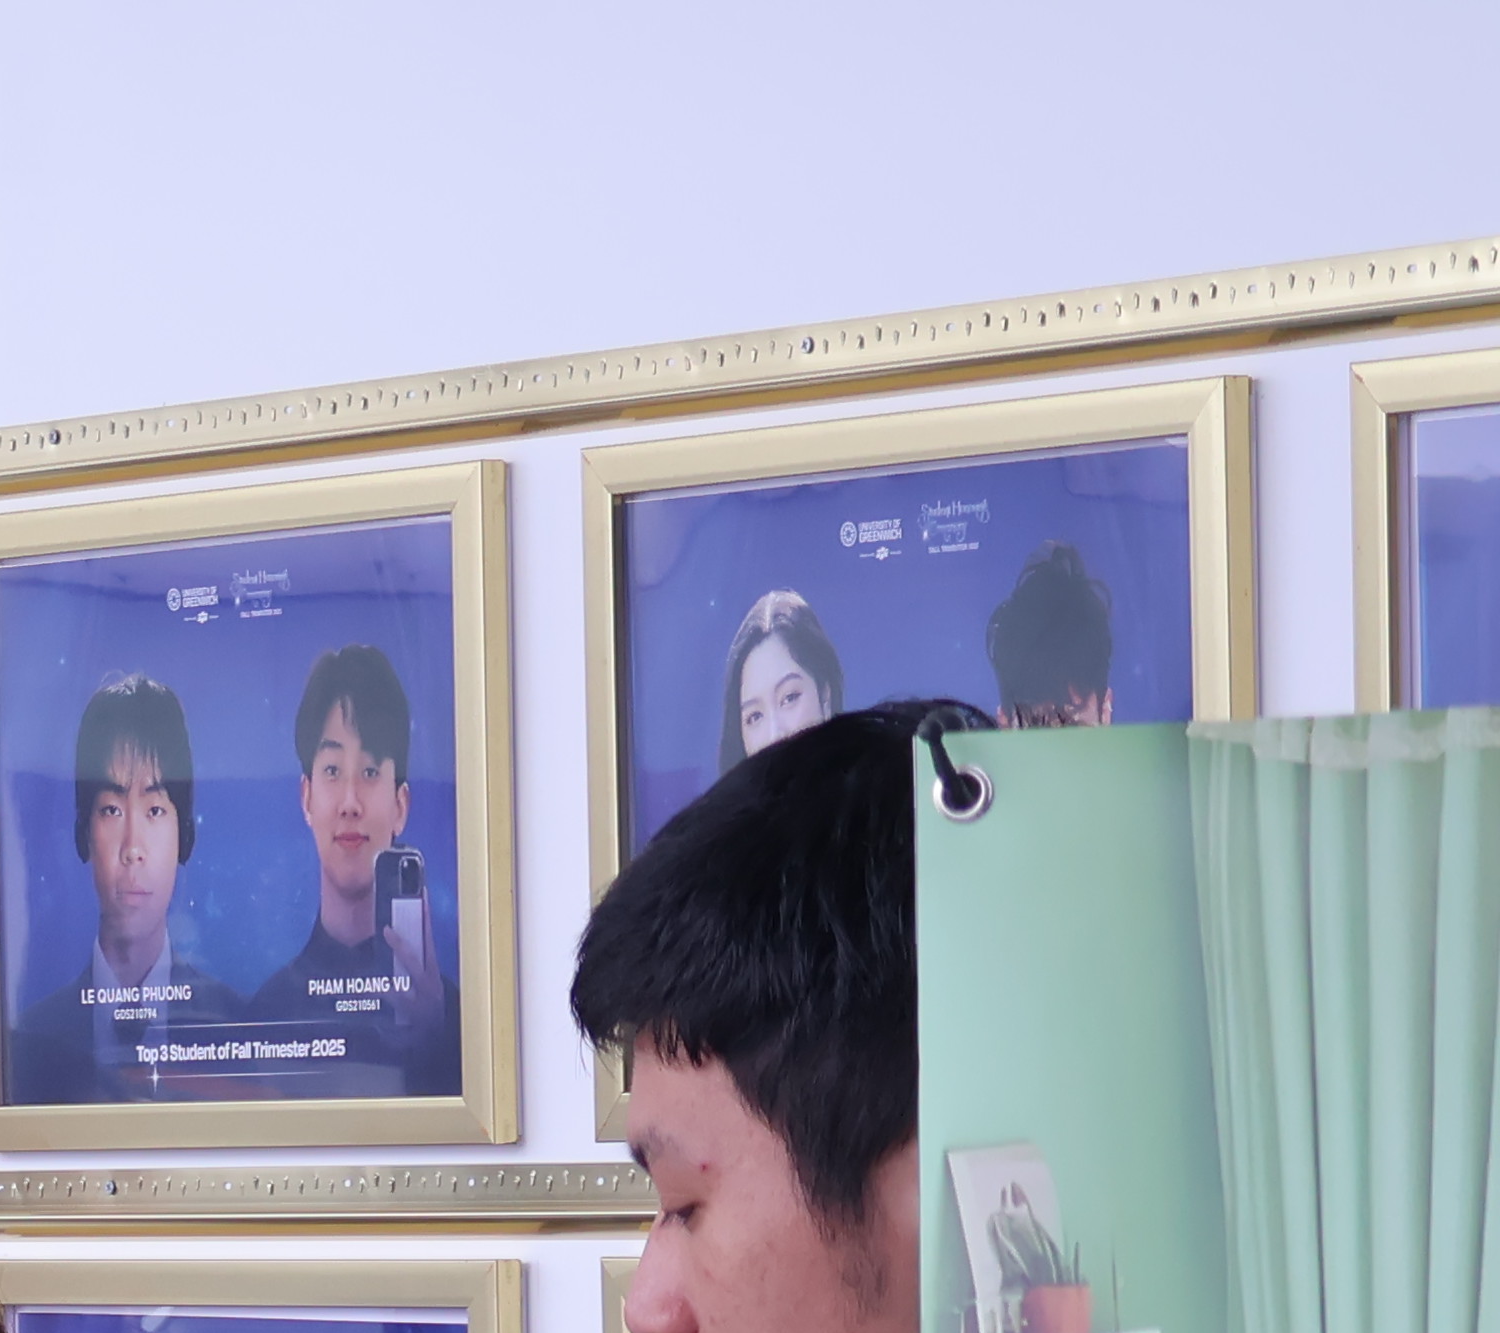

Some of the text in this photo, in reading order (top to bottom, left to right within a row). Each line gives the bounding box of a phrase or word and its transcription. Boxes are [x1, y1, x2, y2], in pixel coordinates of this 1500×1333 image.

[81, 985, 191, 1004] LE QUANG PHUONG
[308, 976, 410, 995] PHAM HOANG VU
[136, 1039, 345, 1064] Top 3 Student of Fall Trimester 2025
